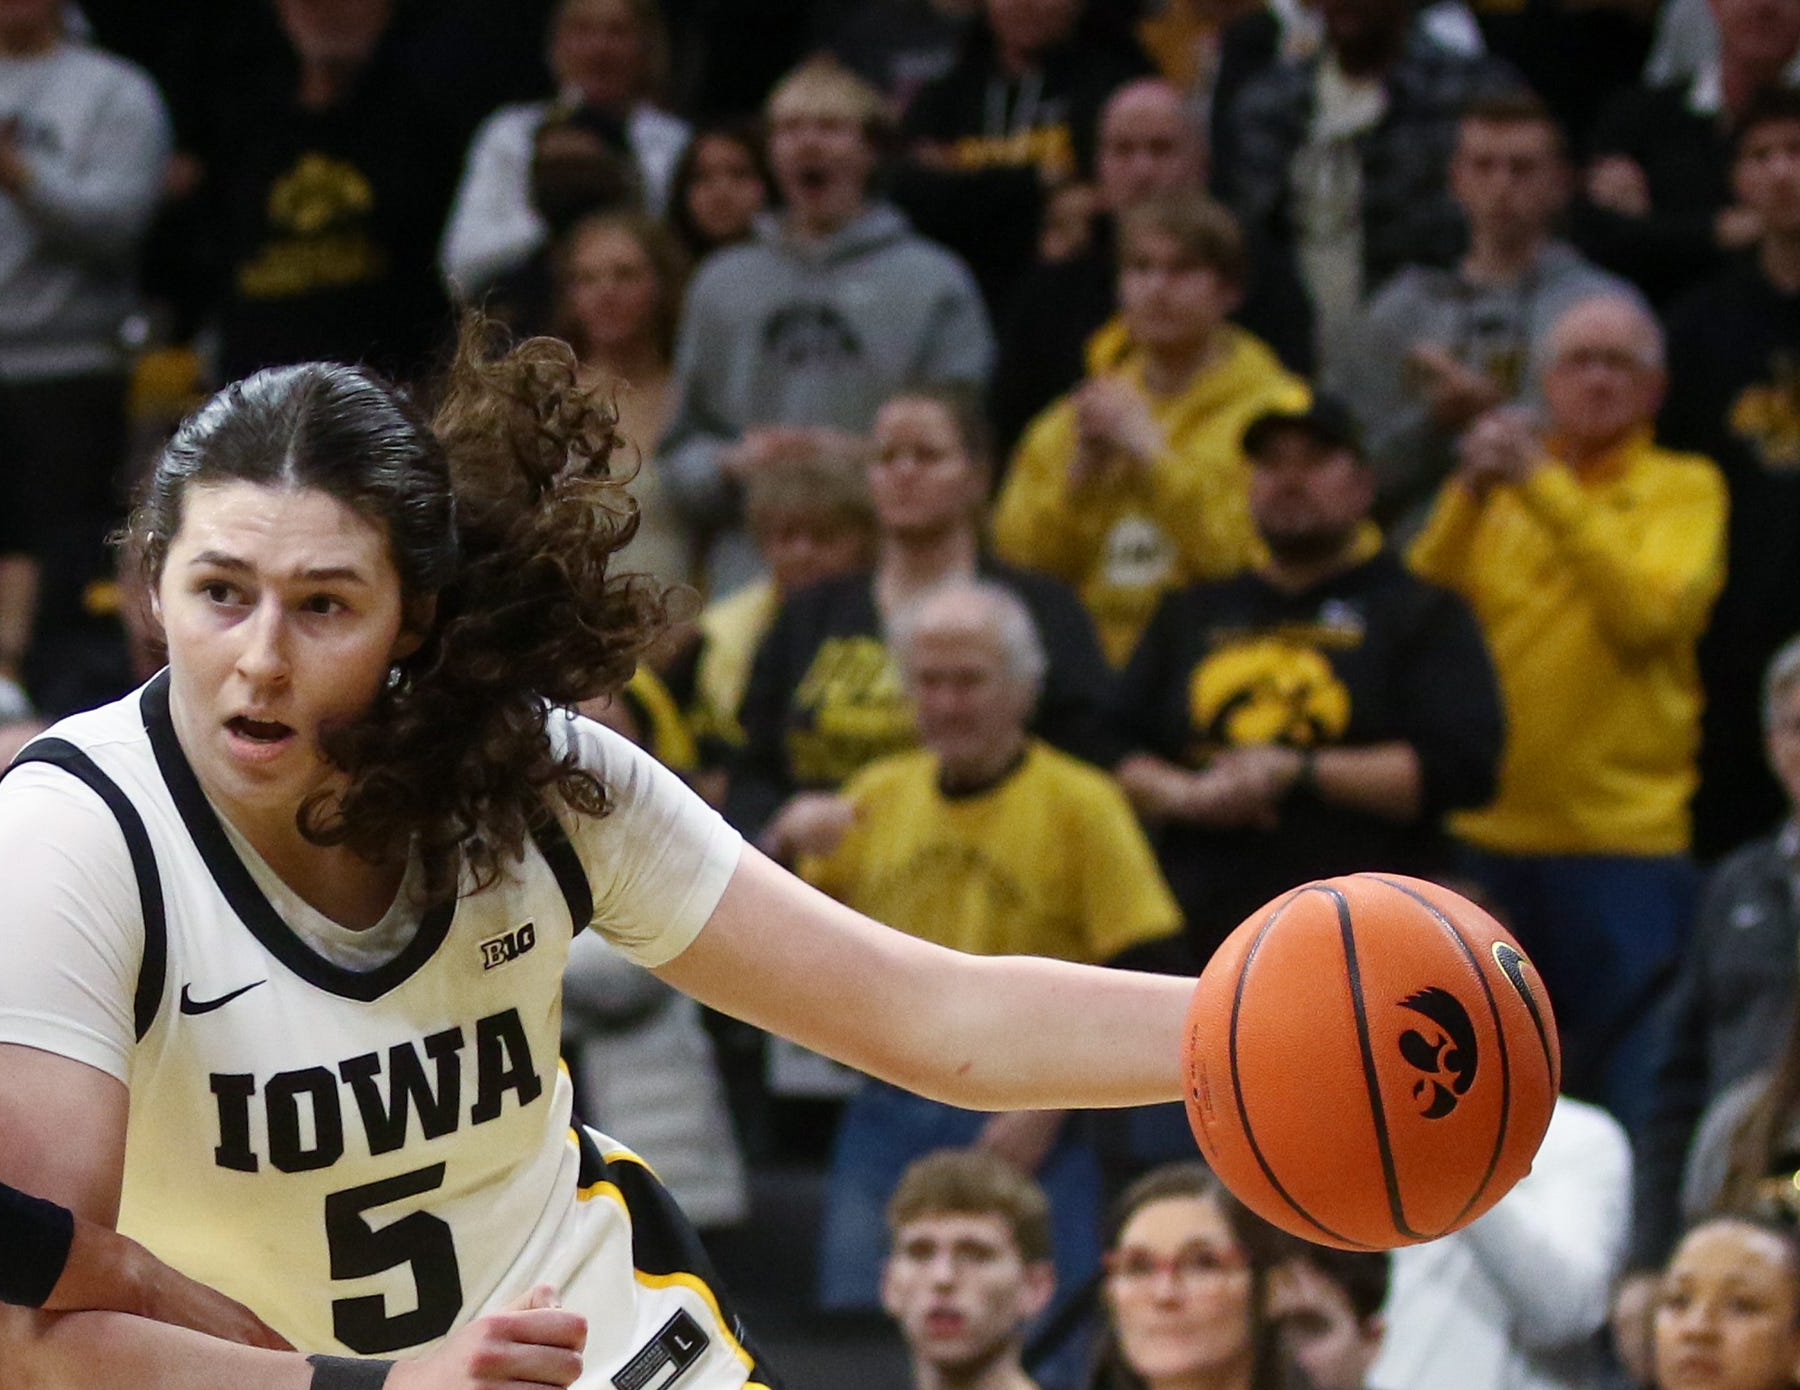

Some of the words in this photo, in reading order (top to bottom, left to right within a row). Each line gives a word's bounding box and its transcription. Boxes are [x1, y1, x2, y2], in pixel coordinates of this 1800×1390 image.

[210, 1007, 542, 1173] IOWA
[325, 1160, 463, 1355] 5
[674, 1335, 693, 1351] L
